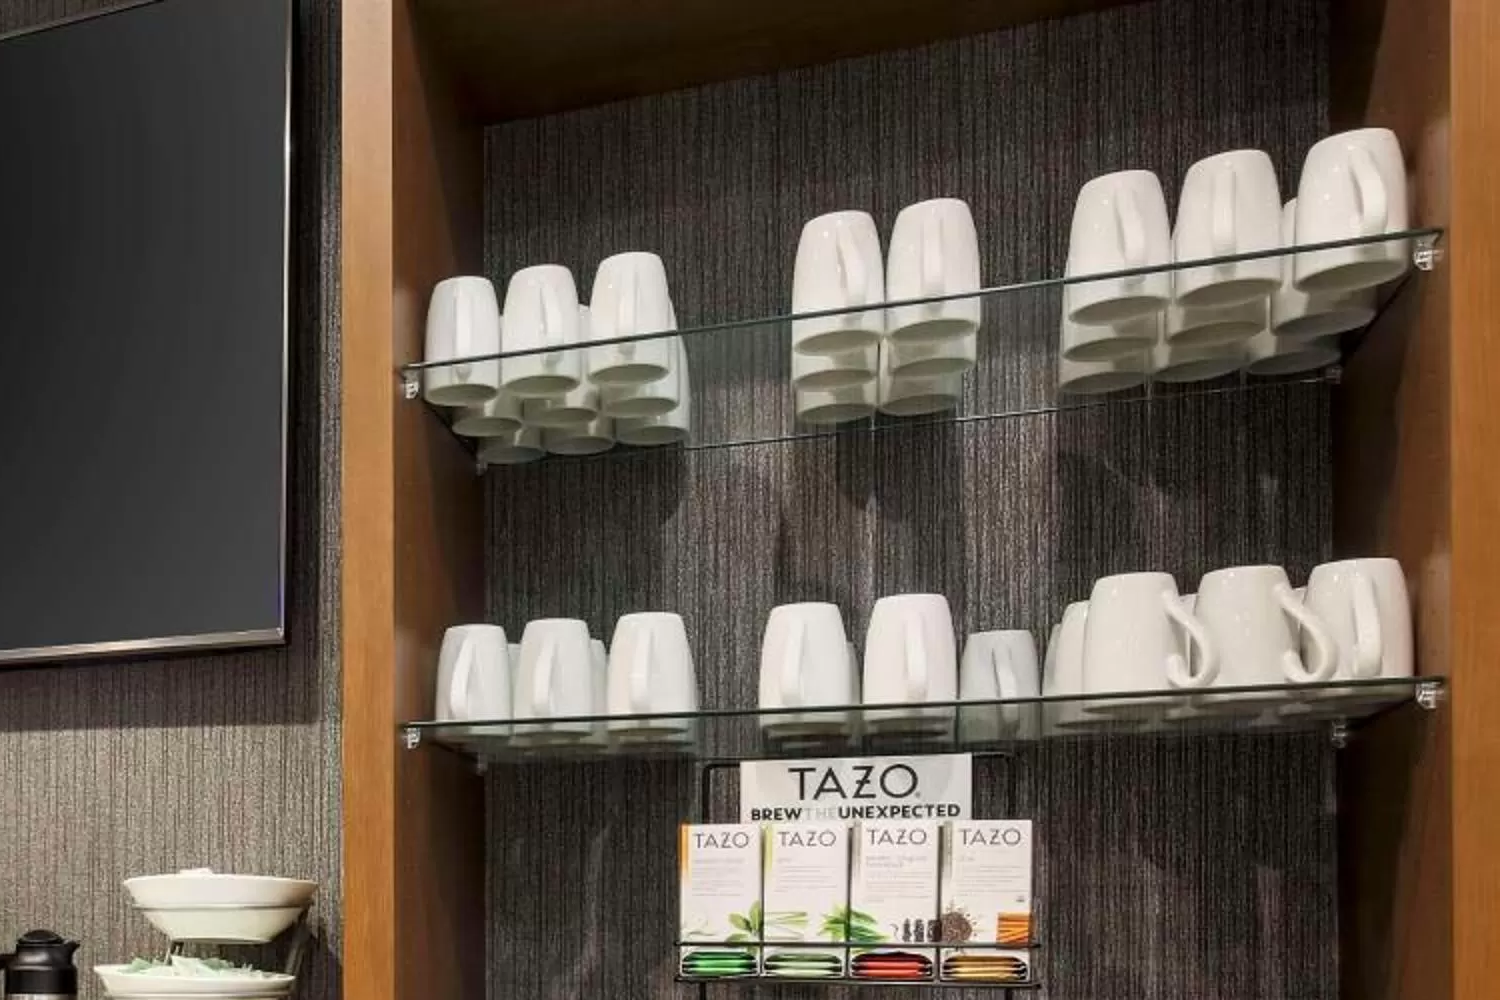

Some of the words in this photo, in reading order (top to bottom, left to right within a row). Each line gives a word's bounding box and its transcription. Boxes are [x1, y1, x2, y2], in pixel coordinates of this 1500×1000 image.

[788, 764, 916, 800] TAZO
[751, 807, 802, 821] BREW
[804, 808, 836, 820] THE
[838, 804, 961, 819] UNEXPECTED
[695, 831, 749, 849] TAZO
[778, 830, 837, 847] TAZO
[867, 828, 927, 845] TAZO
[960, 828, 1021, 845] TAZO
